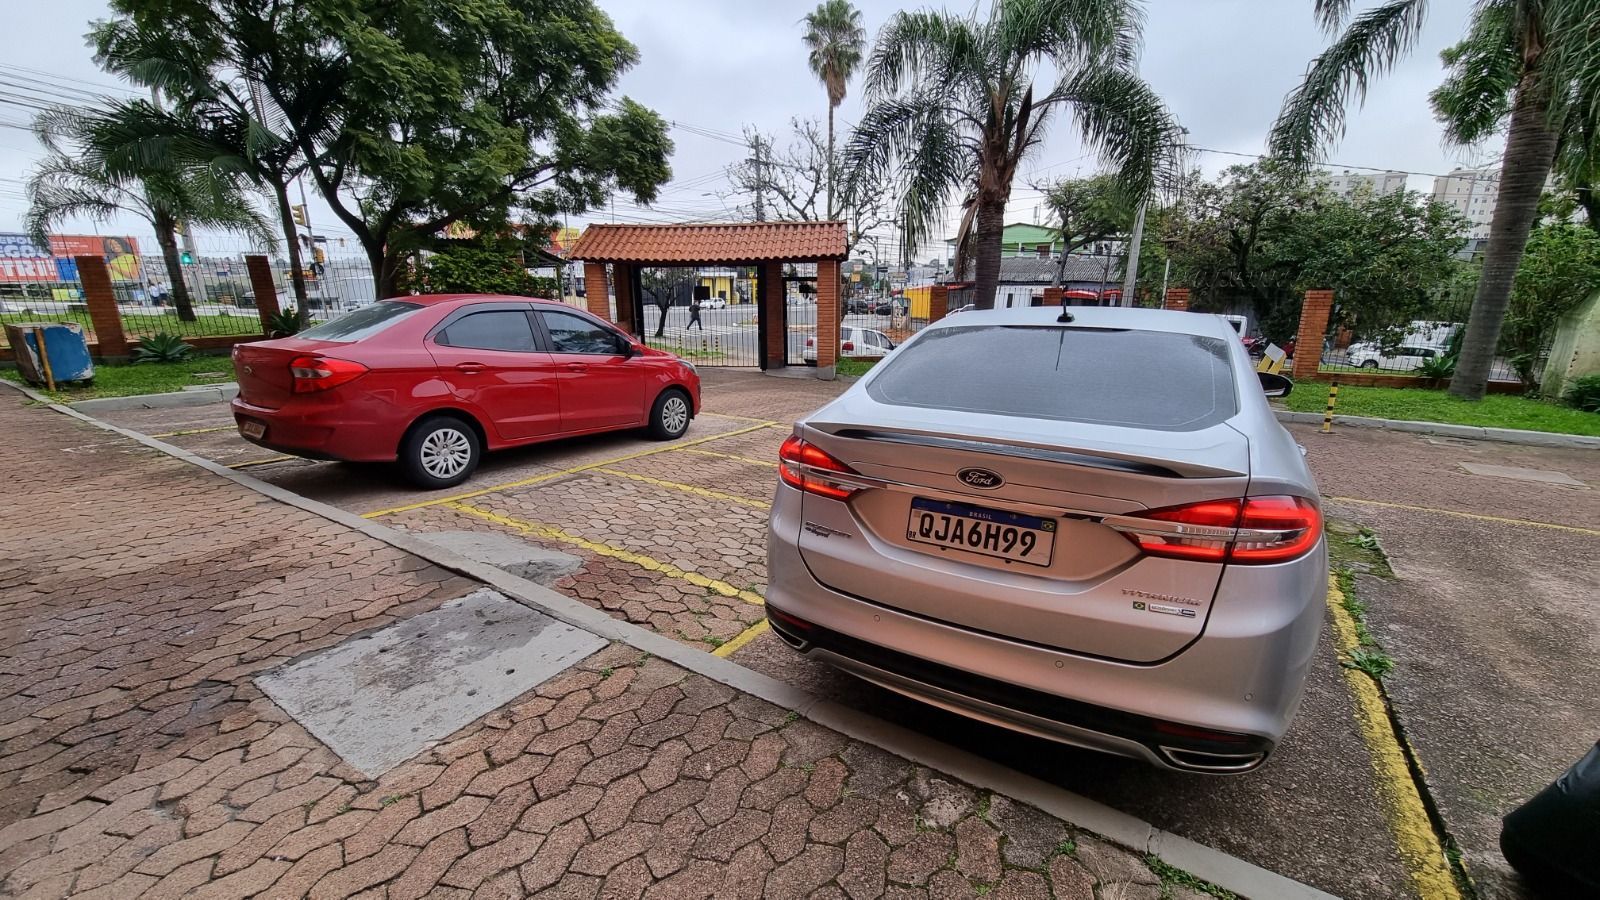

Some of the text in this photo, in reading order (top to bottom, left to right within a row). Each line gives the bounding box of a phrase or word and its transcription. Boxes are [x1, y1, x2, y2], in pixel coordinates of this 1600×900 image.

[966, 471, 994, 485] Ford
[969, 511, 992, 520] BRASIL
[919, 513, 1037, 557] QJA6H99
